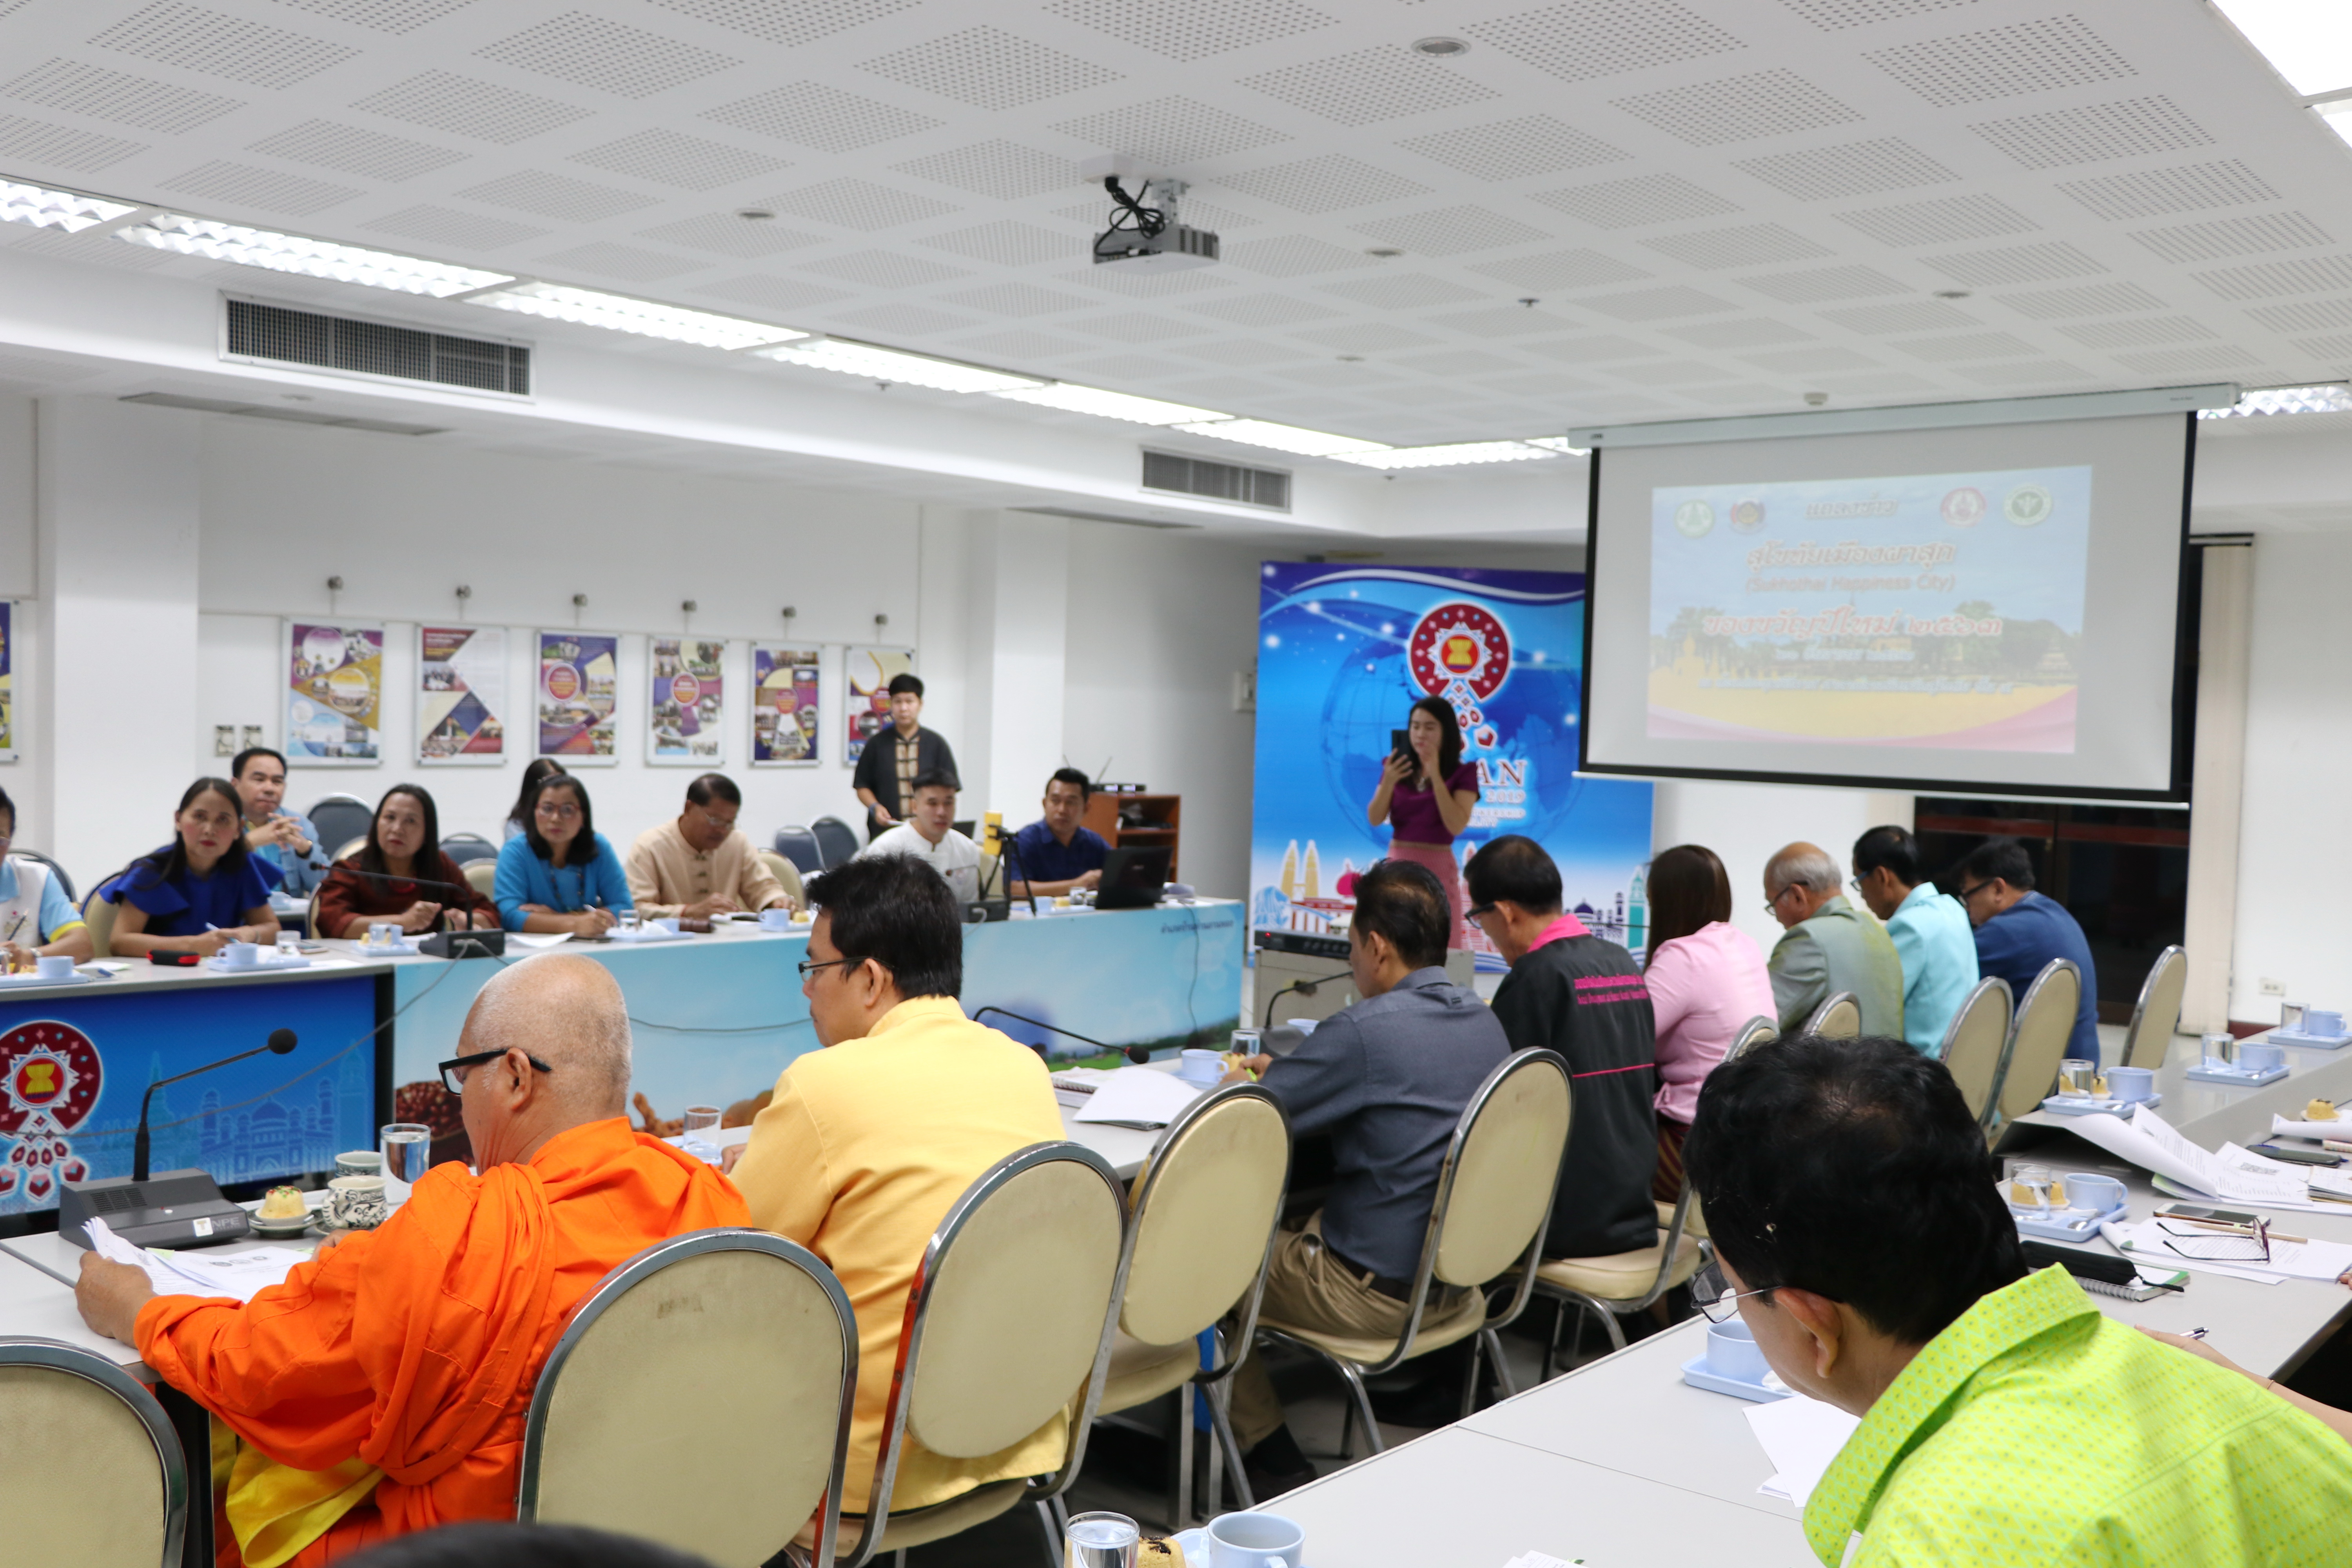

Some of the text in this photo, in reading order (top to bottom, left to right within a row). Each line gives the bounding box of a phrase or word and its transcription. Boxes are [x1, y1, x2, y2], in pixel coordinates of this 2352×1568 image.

[1747, 540, 1955, 572] สุโขทัยเมืองผาสุก
[1703, 604, 1902, 639] ของขวัญปีใหม่
[1485, 789, 1526, 803] 2019
